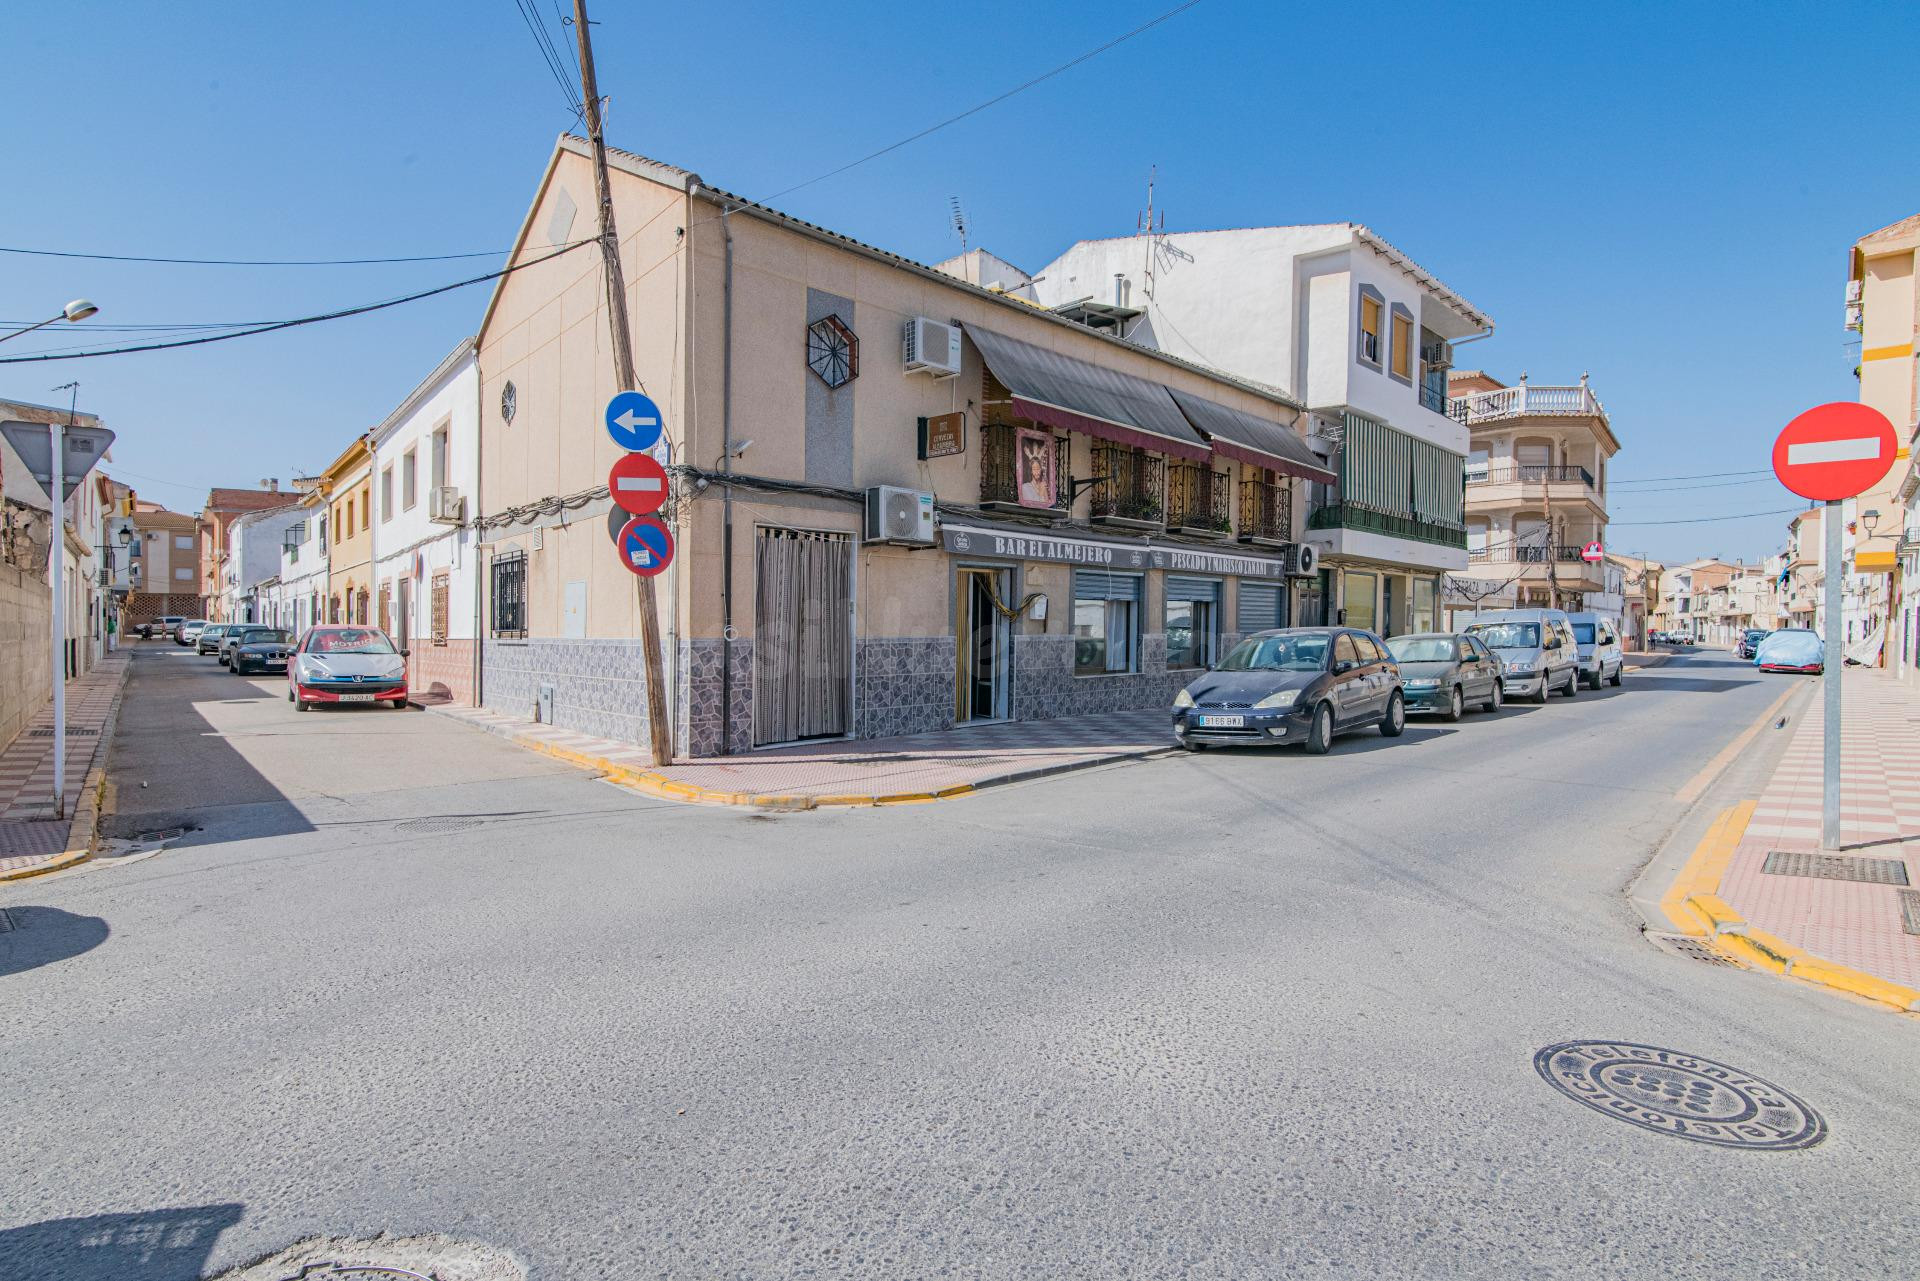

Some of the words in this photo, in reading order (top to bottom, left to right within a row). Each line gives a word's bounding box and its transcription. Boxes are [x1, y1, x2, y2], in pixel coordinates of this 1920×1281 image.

[995, 537, 1026, 556] BAR
[1029, 540, 1045, 558] EL
[1047, 542, 1112, 563] ALMEJERO
[1171, 553, 1206, 570] PESCADO
[1207, 556, 1213, 571] Y
[1213, 557, 1243, 575] MARISCO
[1564, 1046, 1786, 1110] Telefónica
